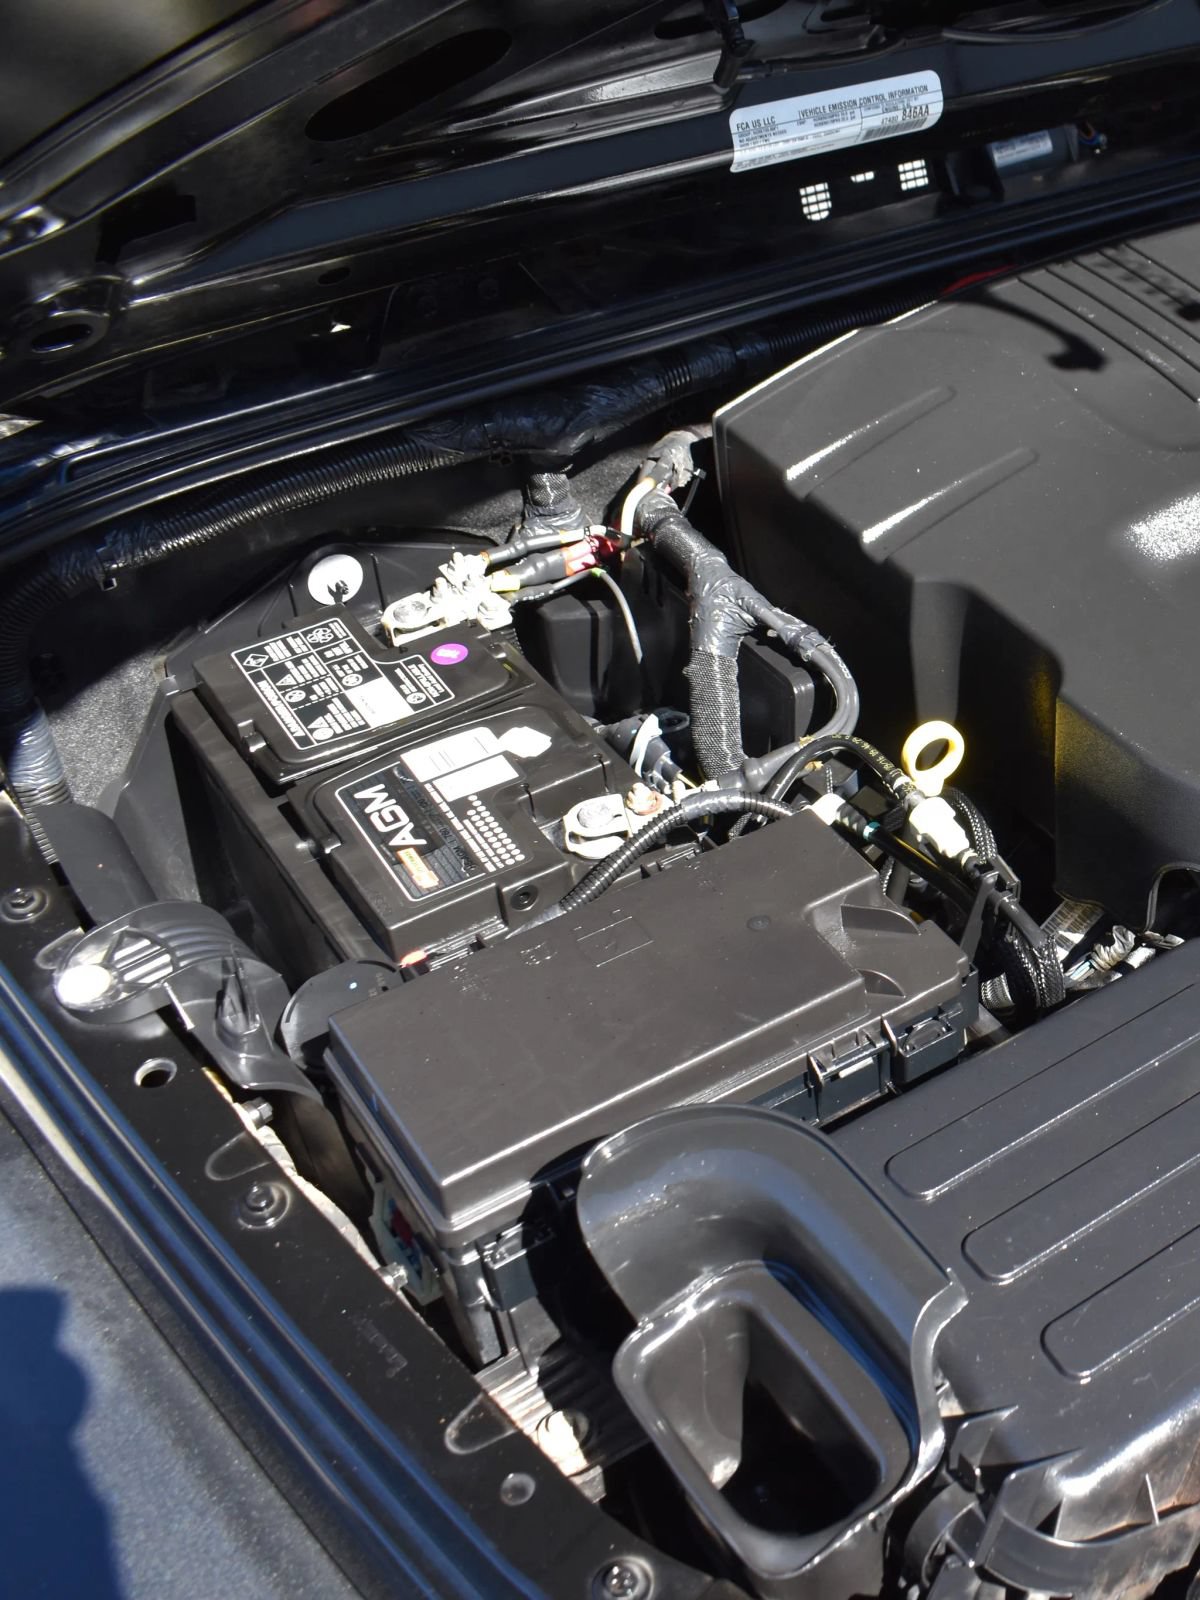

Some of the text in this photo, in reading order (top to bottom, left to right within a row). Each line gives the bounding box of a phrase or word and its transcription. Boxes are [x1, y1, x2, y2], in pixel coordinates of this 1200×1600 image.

[801, 105, 827, 117] VEHICLE
[828, 99, 858, 113] EMISSION
[859, 93, 887, 107] CONTROL
[888, 84, 929, 101] INFORMATION
[735, 122, 750, 131] FCA
[751, 120, 762, 129] US
[763, 116, 776, 126] LLC
[901, 105, 930, 121] 846AA
[353, 783, 428, 846] AGM
